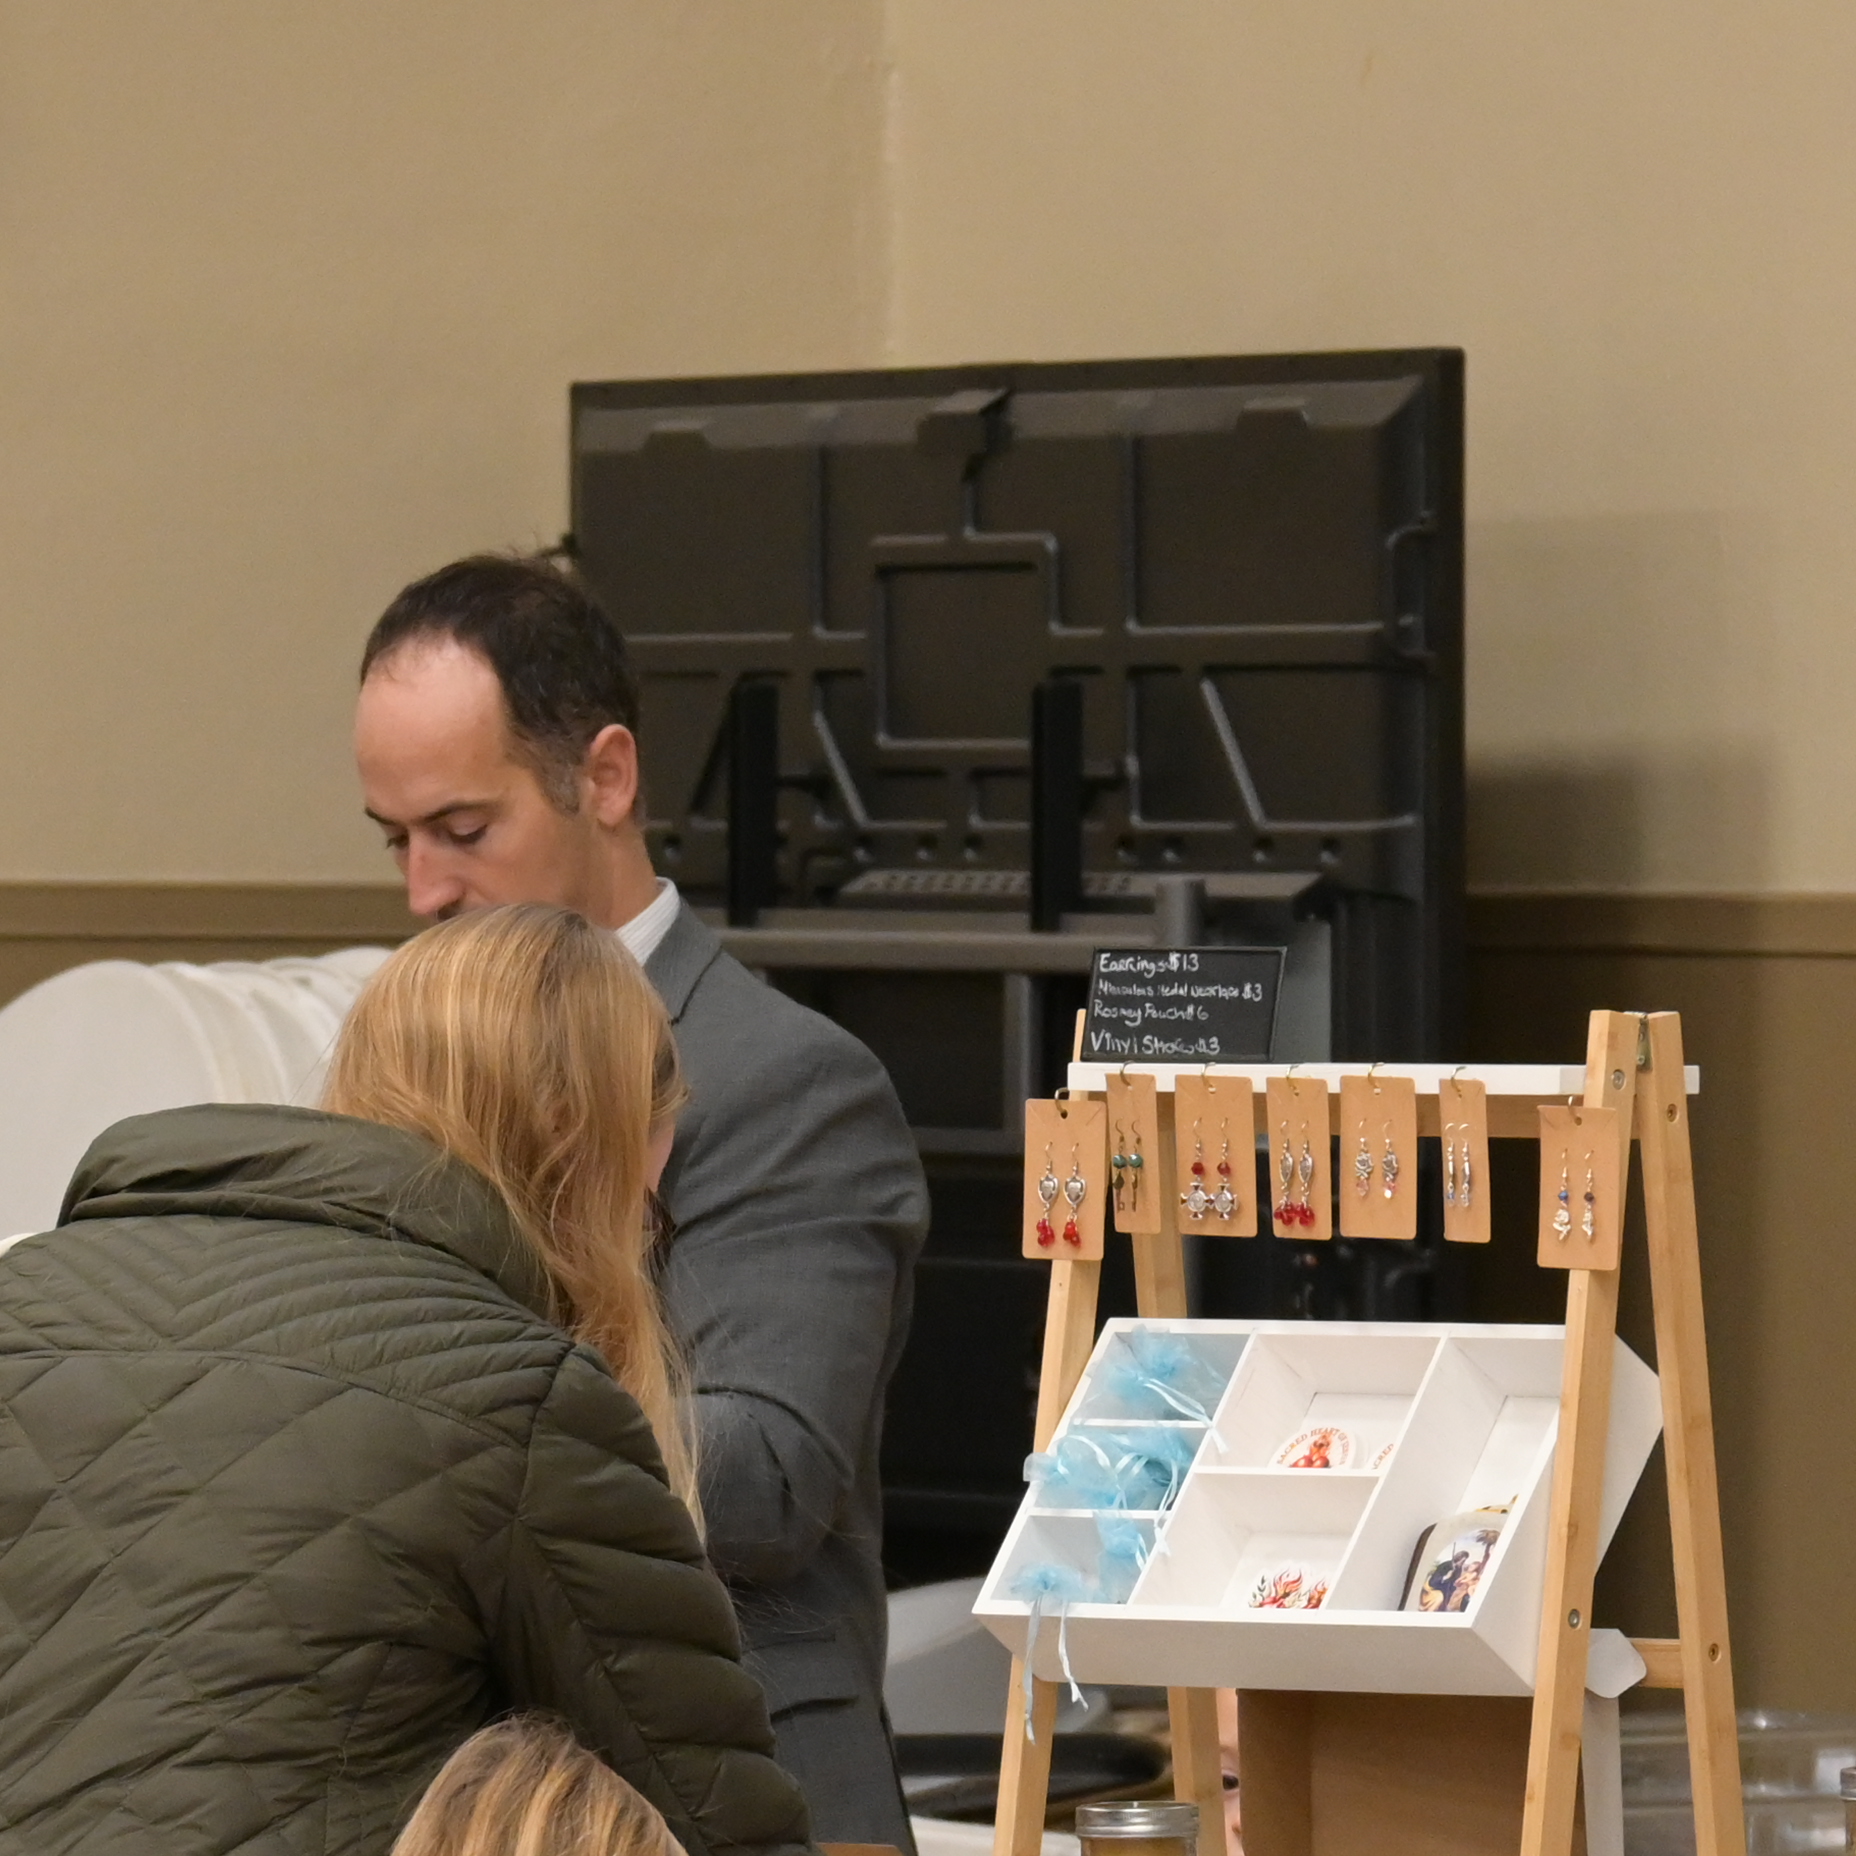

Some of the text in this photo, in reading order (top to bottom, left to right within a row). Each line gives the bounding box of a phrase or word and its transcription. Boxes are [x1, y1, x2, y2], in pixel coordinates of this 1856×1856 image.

[1099, 951, 1200, 978] Earrings $13
[1145, 1002, 1185, 1020] Pouch
[1091, 1029, 1138, 1054] Vinyl
[1276, 1433, 1308, 1465] SACRED
[1310, 1427, 1341, 1438] HEART
[1372, 1443, 1395, 1470] CRED
